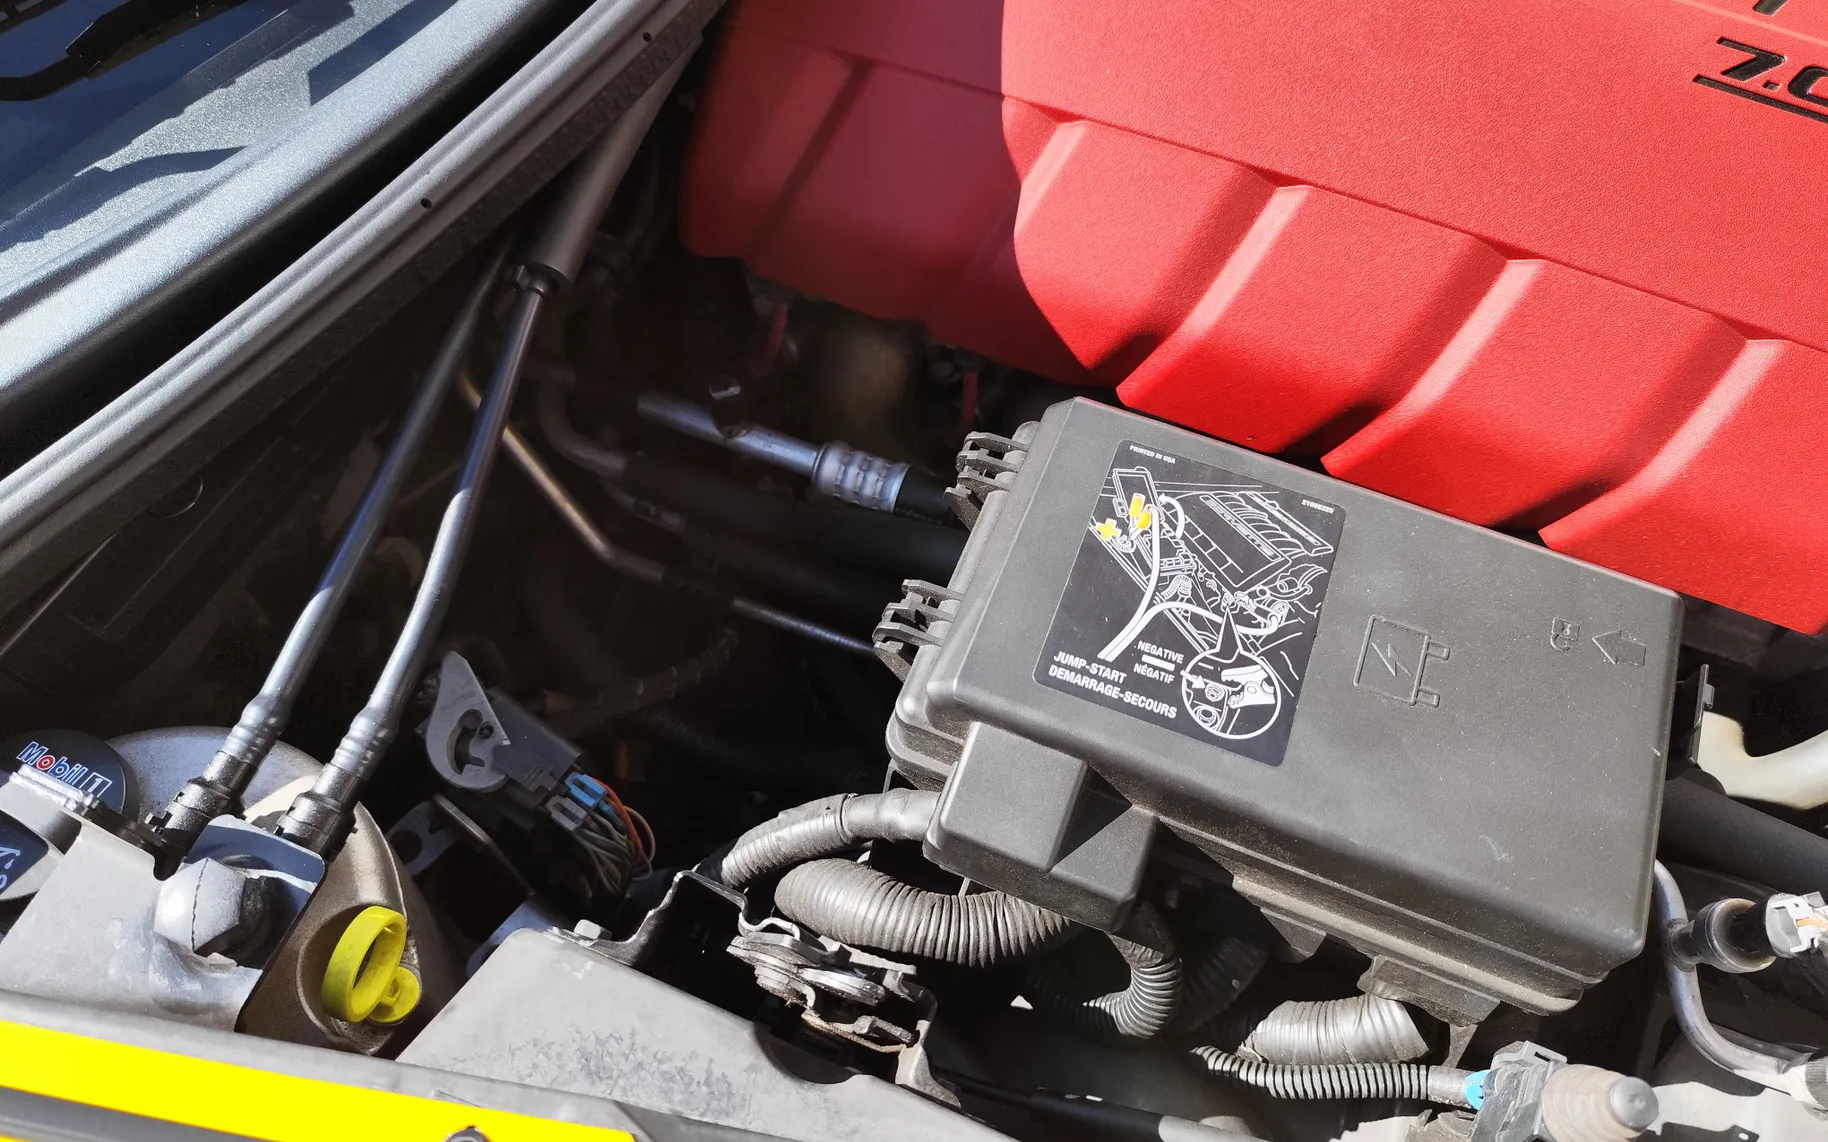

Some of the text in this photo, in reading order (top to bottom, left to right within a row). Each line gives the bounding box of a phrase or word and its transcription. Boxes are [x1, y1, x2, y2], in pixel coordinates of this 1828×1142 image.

[1130, 444, 1176, 464] PRINTED IN USA
[1137, 640, 1185, 664] NEGATIVE
[1053, 651, 1127, 684] JUMP-START
[1133, 663, 1175, 684] NÉGATIF
[1048, 664, 1178, 719] DEMARRAGE-SECOURS
[16, 741, 88, 785] Mobil
